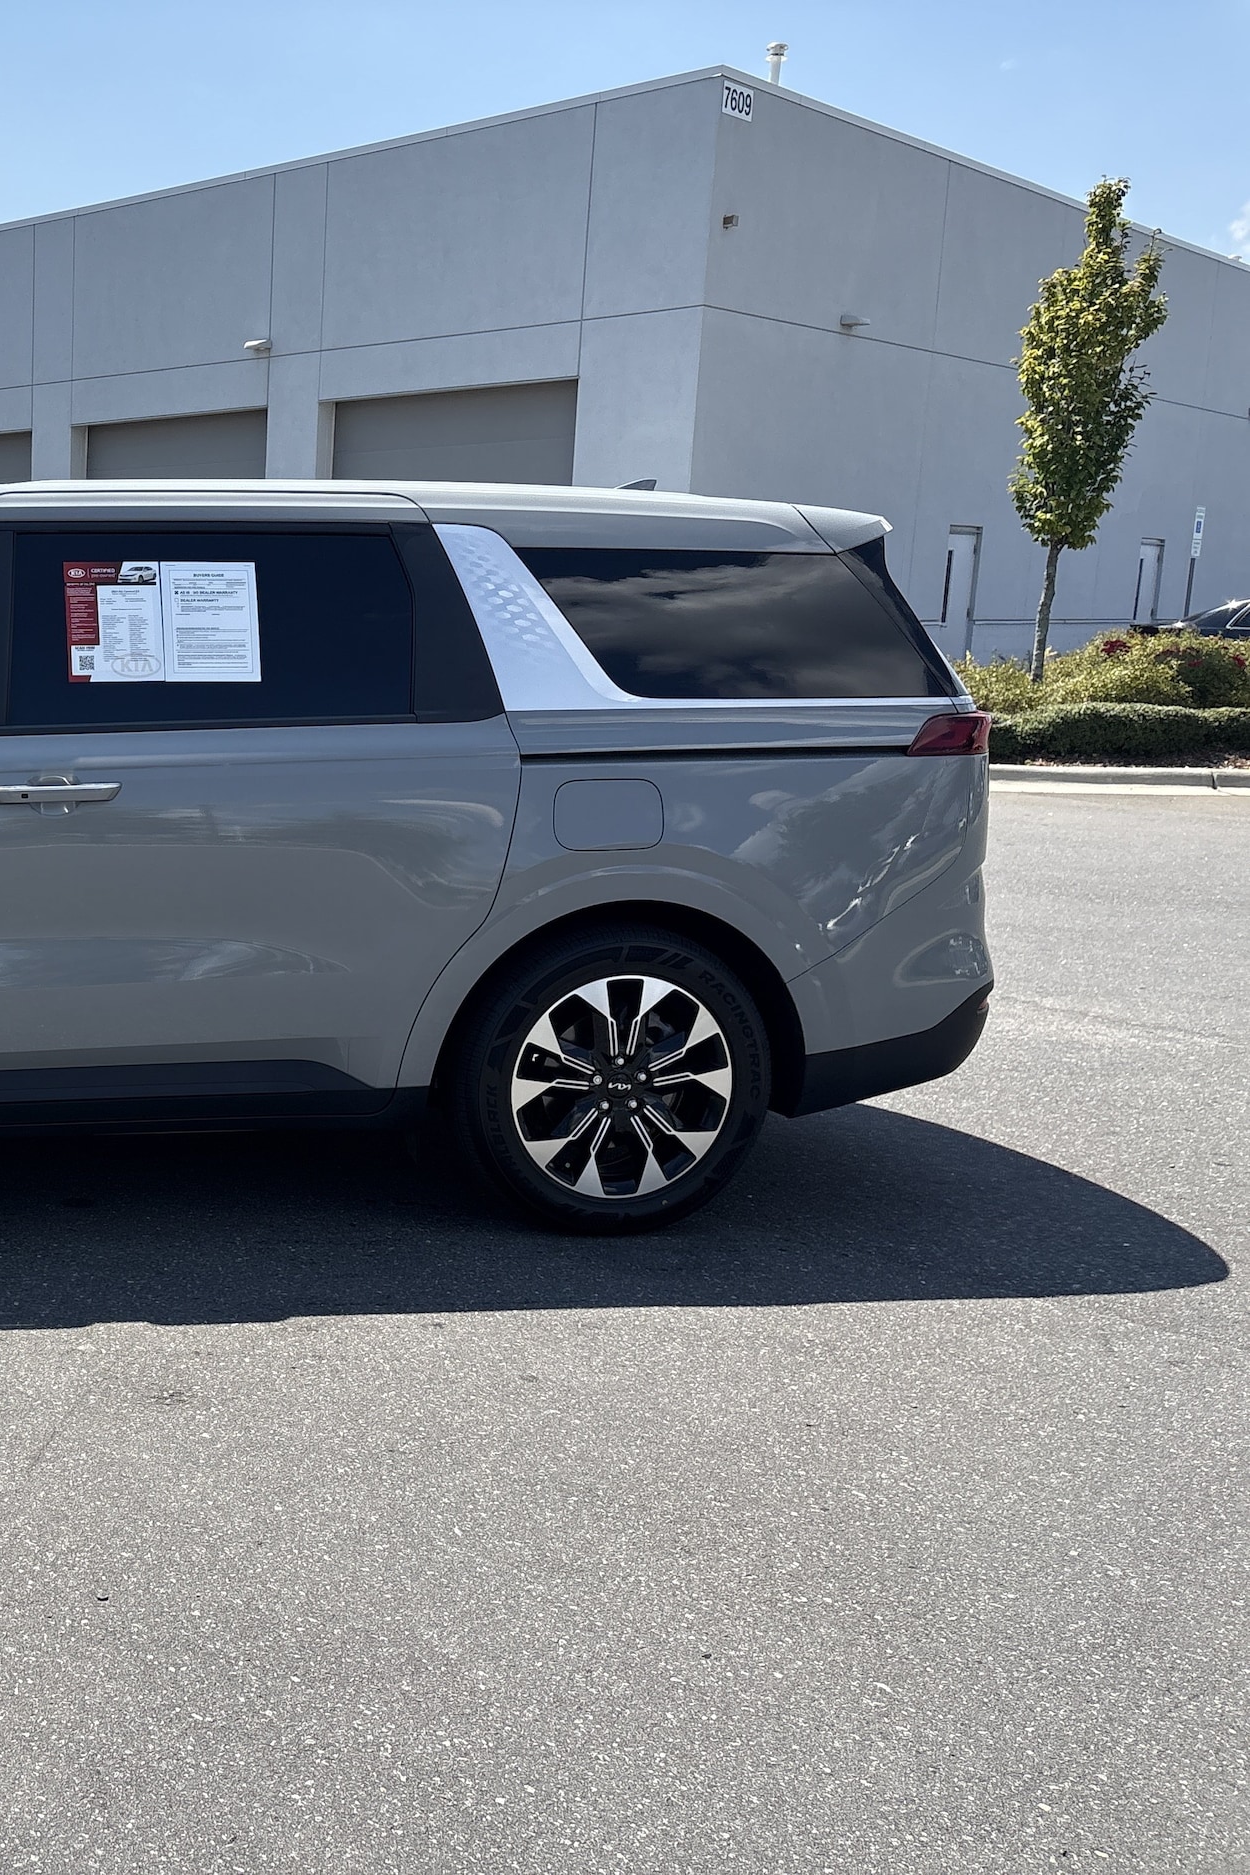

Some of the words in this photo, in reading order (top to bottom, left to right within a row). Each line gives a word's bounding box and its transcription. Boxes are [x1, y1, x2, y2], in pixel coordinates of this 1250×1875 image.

[724, 86, 752, 116] 7609
[121, 660, 153, 672] KIA
[698, 970, 762, 1100] RACINGTRAC
